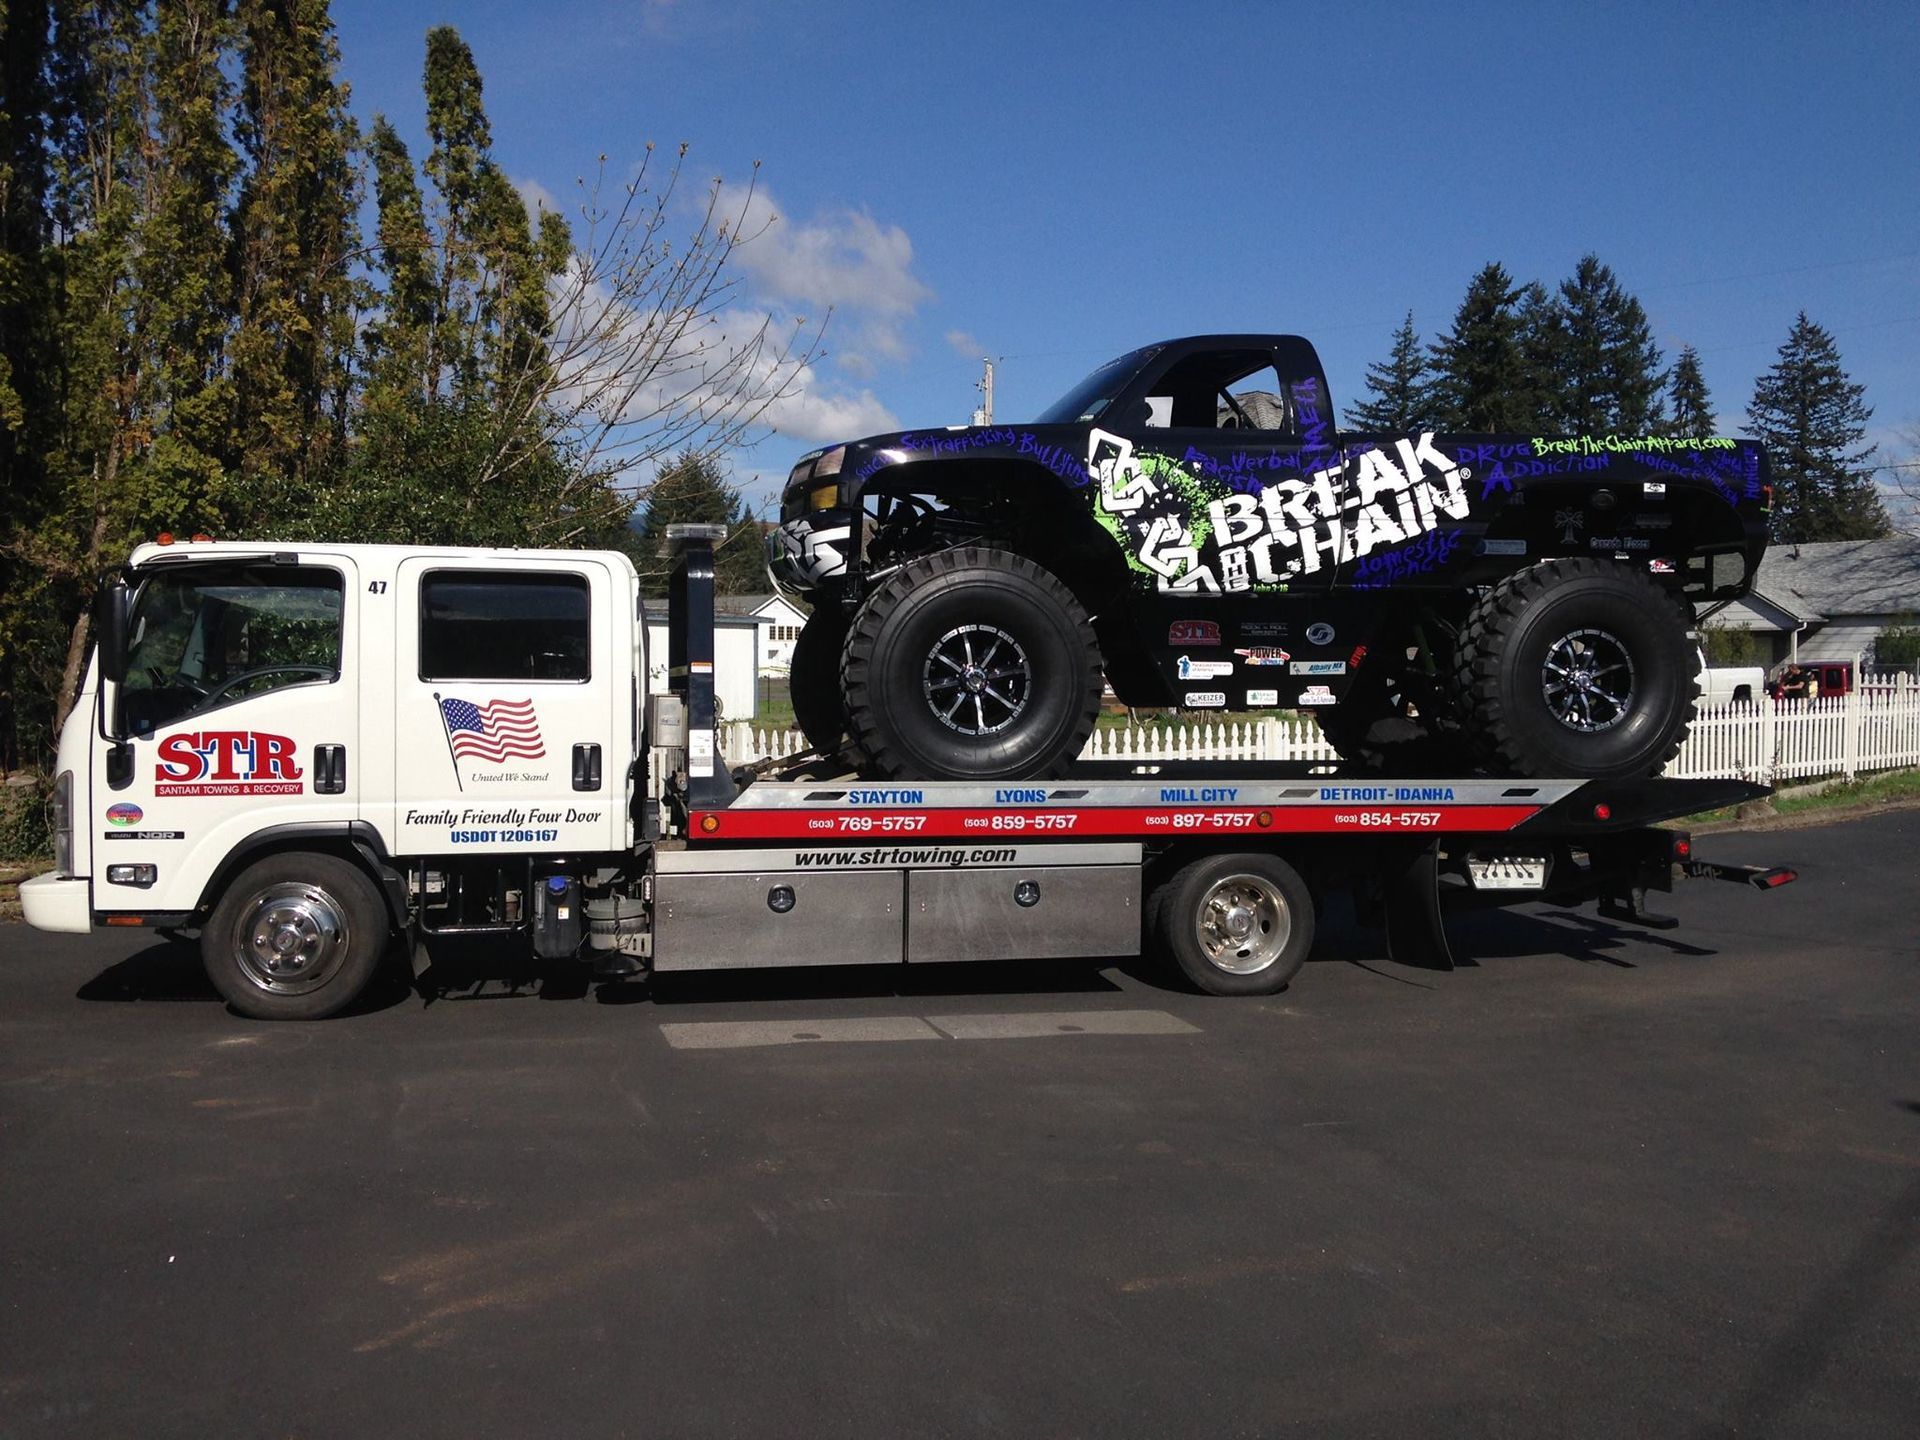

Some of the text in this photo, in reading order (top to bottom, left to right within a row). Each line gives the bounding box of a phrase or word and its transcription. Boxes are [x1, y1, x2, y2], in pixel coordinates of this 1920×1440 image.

[1208, 432, 1456, 548] BREAK
[1218, 546, 1251, 592] THE
[368, 581, 387, 594] 47
[1170, 621, 1221, 639] STR
[1250, 648, 1281, 658] POWER
[155, 732, 303, 781] STR
[472, 772, 549, 782] United We Stand
[159, 784, 299, 795] SANTIAM TOWING & RECOVERY
[995, 789, 1046, 803] LYONS
[1161, 788, 1238, 802] MILL CITY
[1320, 787, 1454, 801] DETROIT-IDANHA
[848, 790, 923, 804] STAYTON
[405, 807, 601, 828] Family Friendly Four Door
[808, 816, 927, 831] (503) 769-5757
[964, 814, 1077, 830] (503) 859-5757
[1145, 812, 1254, 827] (503) 897-5757
[1335, 812, 1441, 826] (503) 854-5757
[450, 829, 558, 843] USDOT 1206167
[794, 847, 1018, 867] www.strtowing.com
